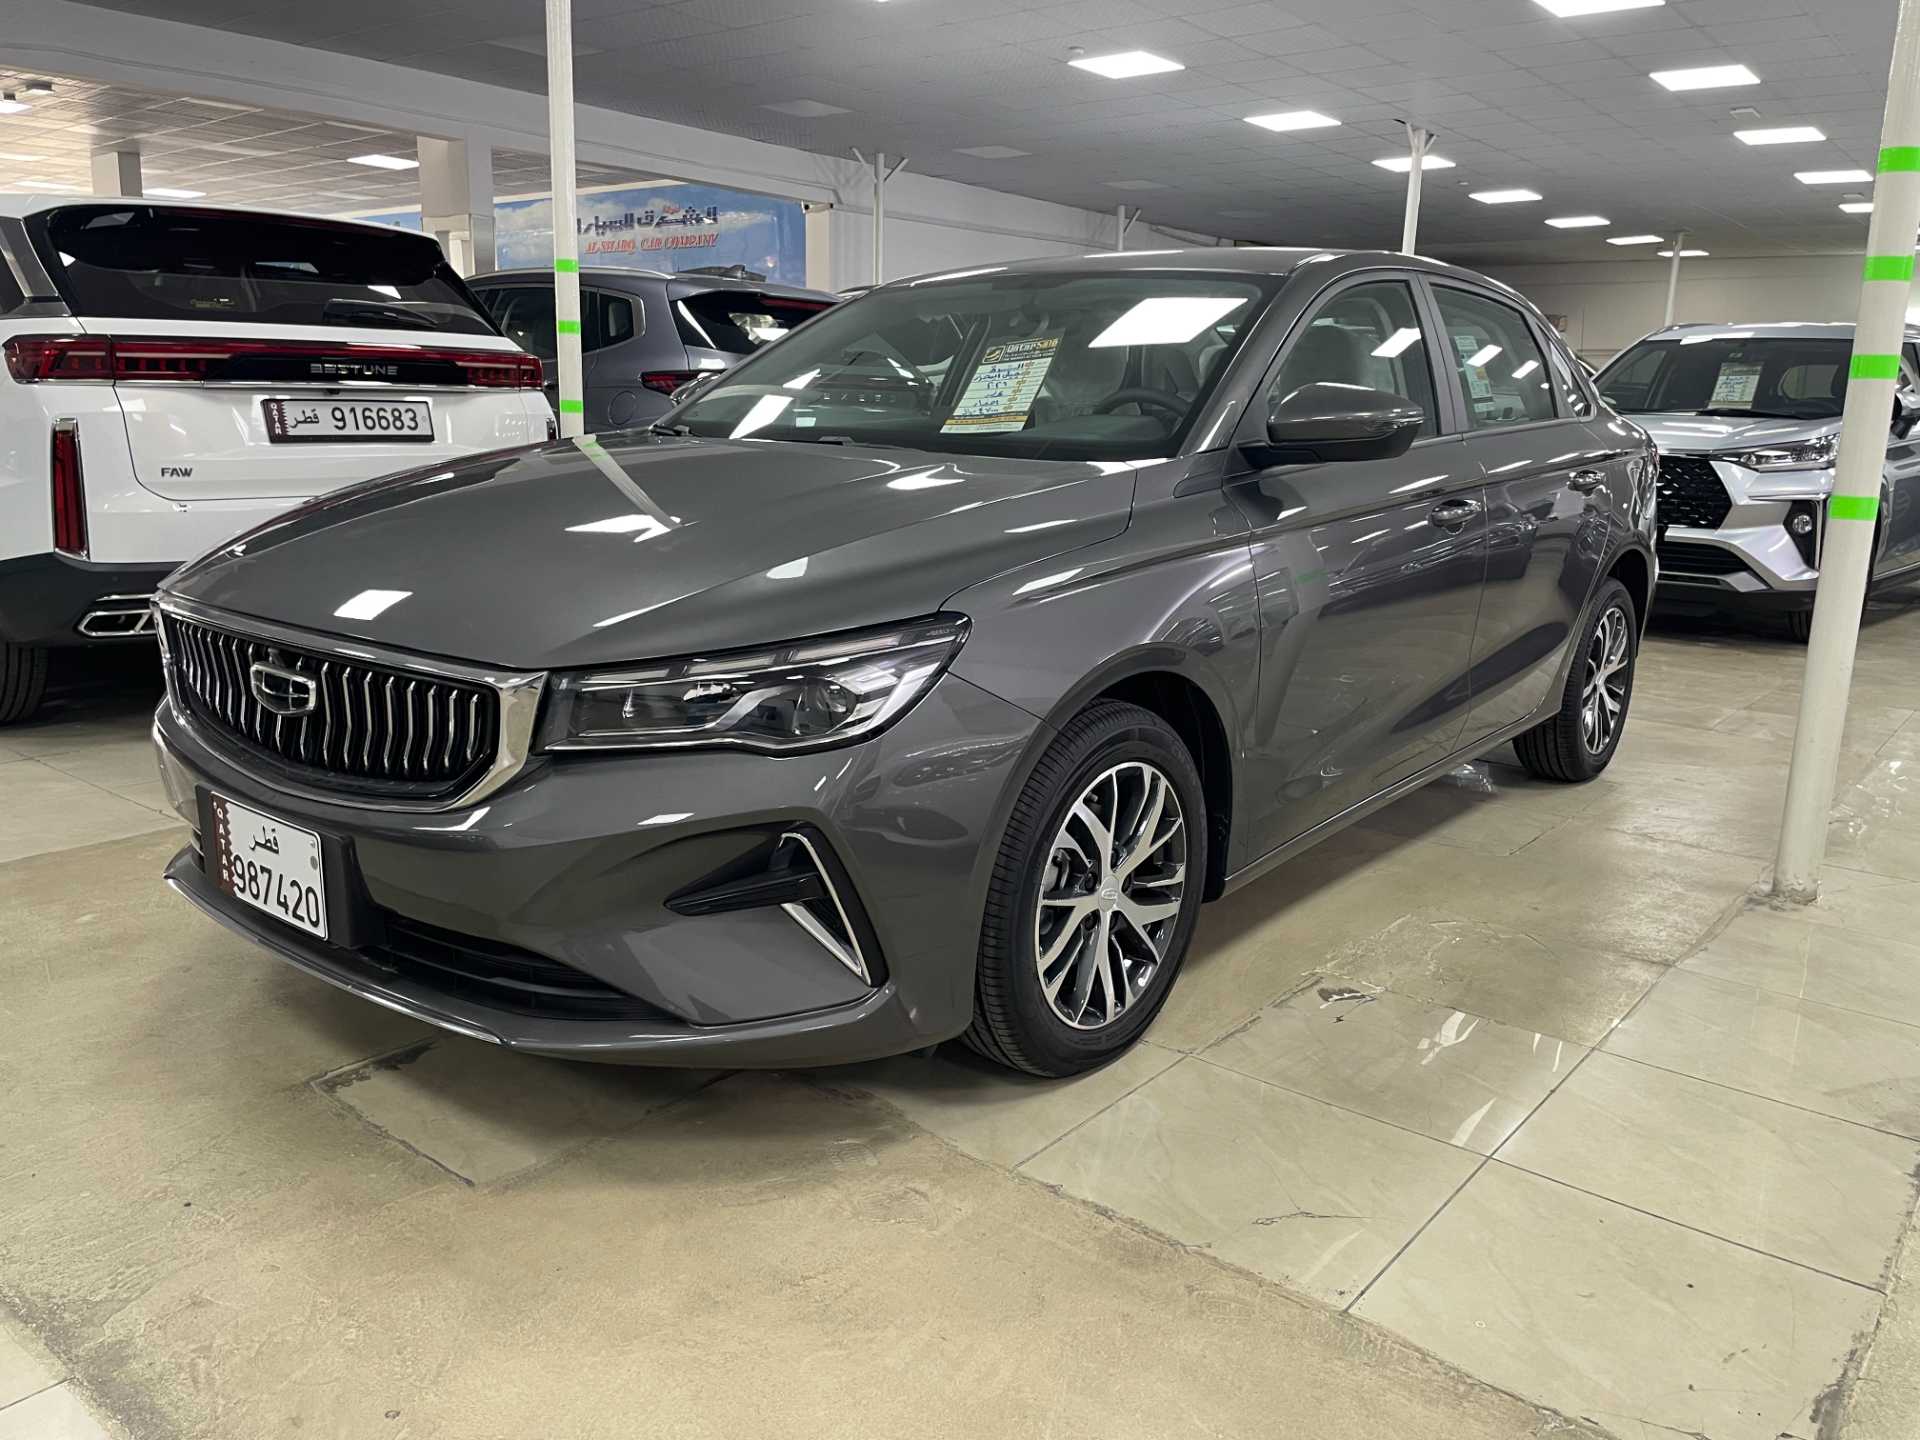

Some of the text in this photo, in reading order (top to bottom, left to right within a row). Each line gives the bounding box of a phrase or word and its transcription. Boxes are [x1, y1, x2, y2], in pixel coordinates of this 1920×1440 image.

[640, 236, 662, 251] CAR
[664, 232, 719, 249] COMPANY
[310, 363, 398, 375] BESTUNE
[270, 402, 282, 435] QATAR
[289, 408, 320, 429] قطر
[331, 406, 419, 431] 916683
[160, 467, 193, 478] FAW
[216, 807, 230, 881] QATAR
[249, 825, 280, 855] قطر
[232, 853, 321, 929] 987420
